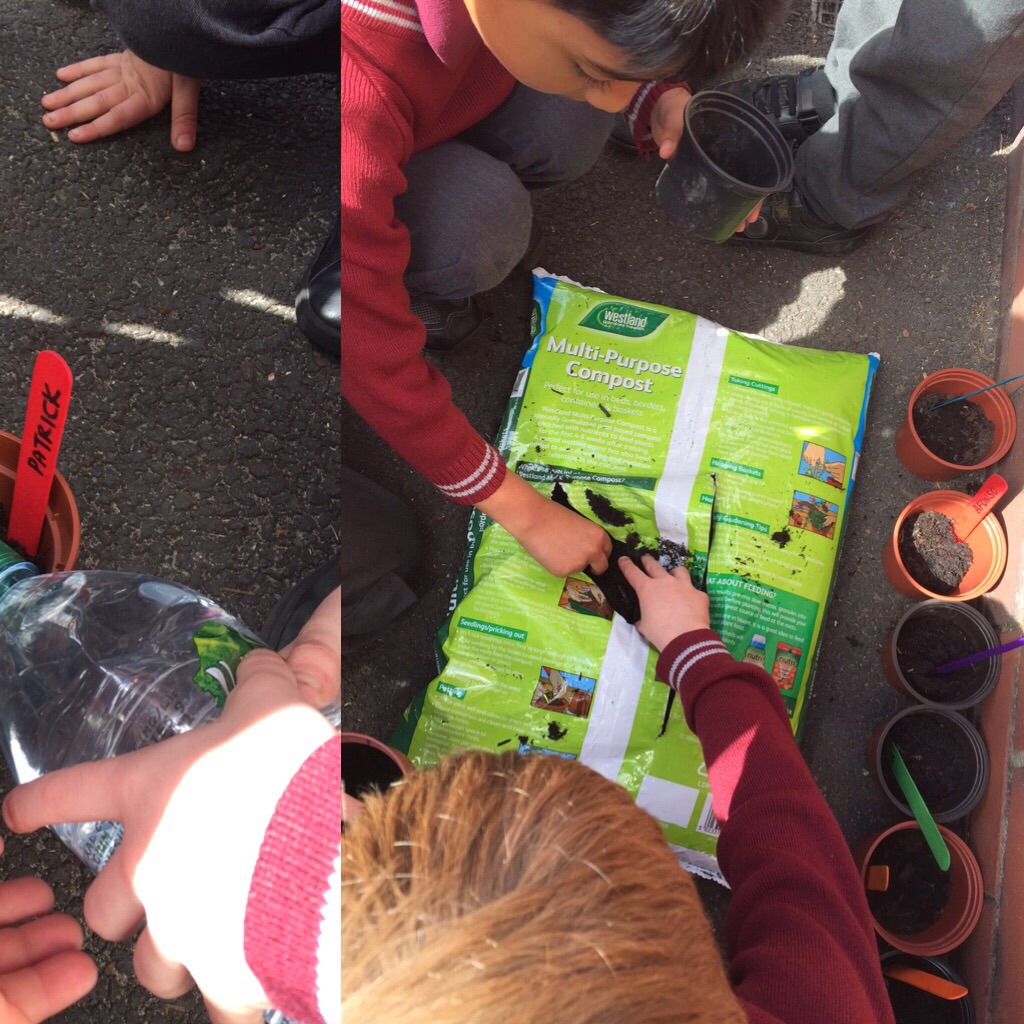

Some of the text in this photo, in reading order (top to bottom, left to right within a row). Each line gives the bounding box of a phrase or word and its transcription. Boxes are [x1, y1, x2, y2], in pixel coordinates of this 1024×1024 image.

[547, 336, 683, 379] Multi-Purpose
[566, 360, 654, 393] Compost
[750, 381, 776, 392] Cuttings
[543, 380, 571, 393] Perfect
[573, 387, 584, 395] for
[585, 391, 599, 399] use
[560, 394, 602, 410] container
[27, 382, 61, 476] PATRICK
[973, 487, 999, 514] AFONSO
[461, 573, 470, 584] for
[716, 575, 743, 589] ABOUT
[742, 582, 777, 599] FEEDING?
[459, 618, 524, 639] Seedlings/pricking out
